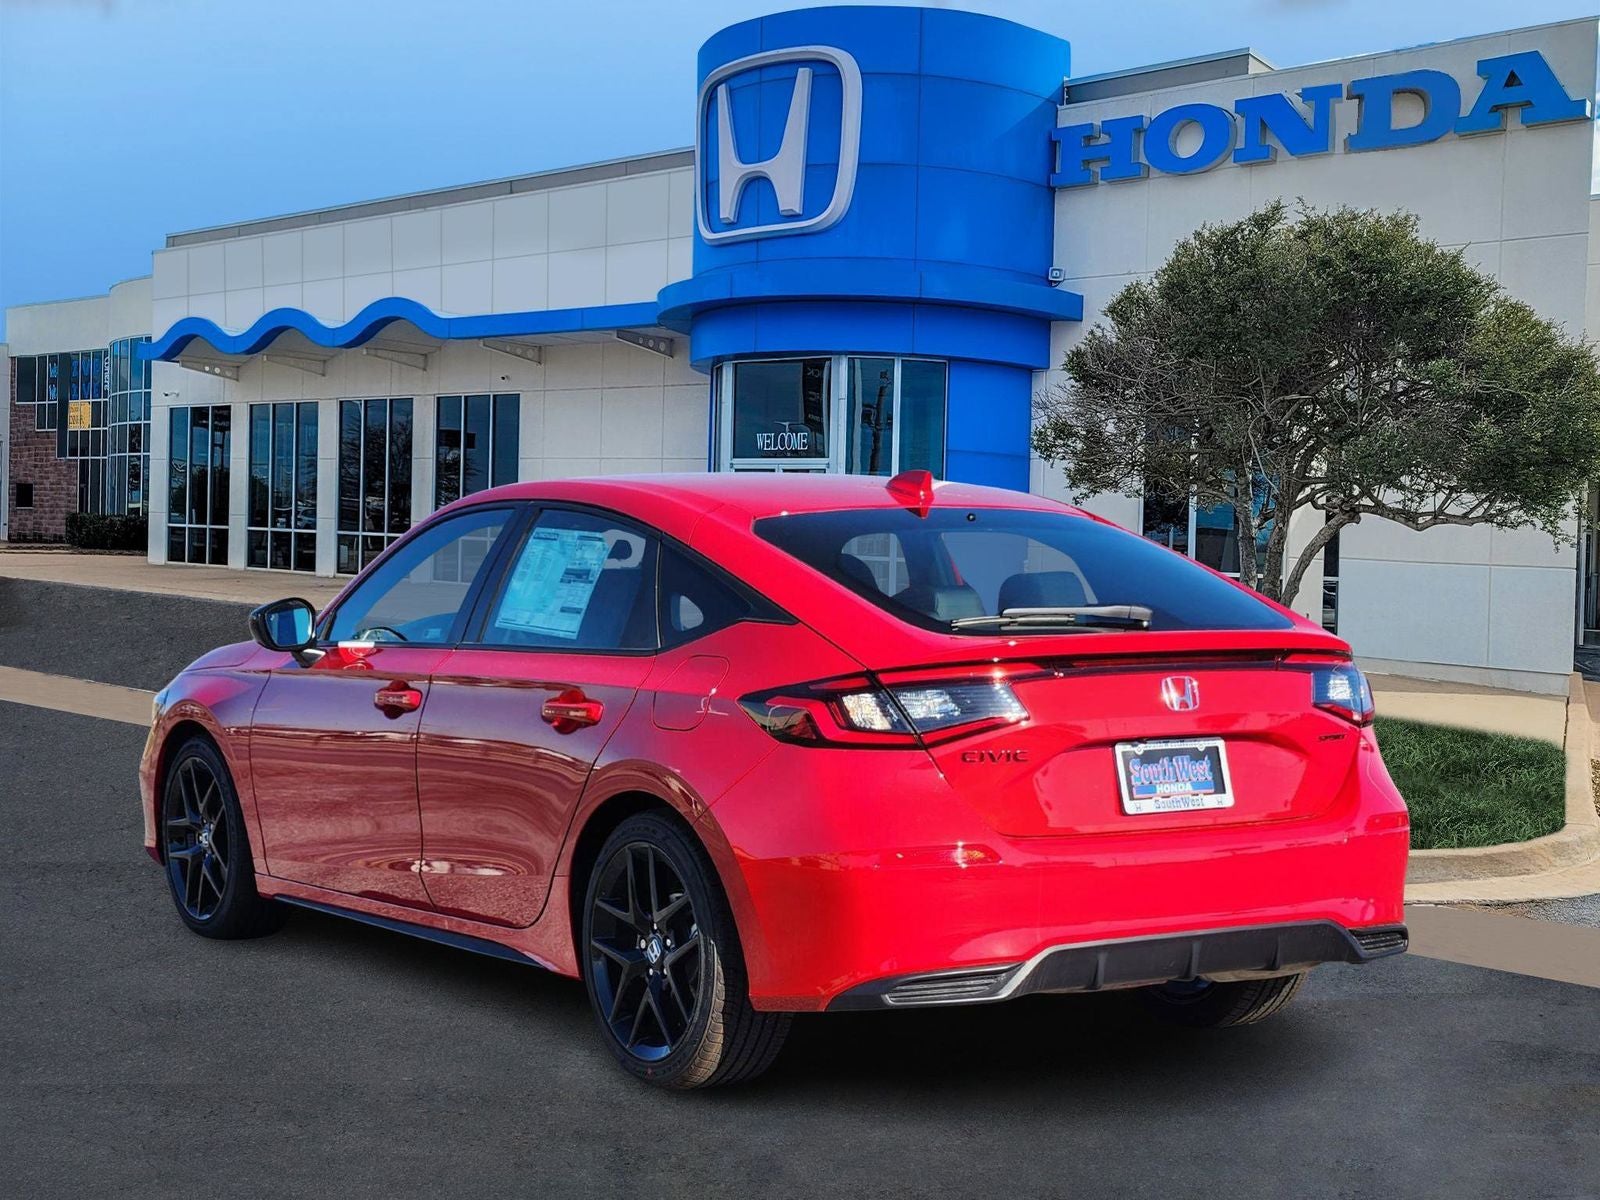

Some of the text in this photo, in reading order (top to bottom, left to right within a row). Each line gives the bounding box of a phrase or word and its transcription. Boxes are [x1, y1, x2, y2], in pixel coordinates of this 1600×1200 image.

[1050, 50, 1592, 188] HONDA
[756, 432, 809, 451] WELCOME
[961, 750, 1029, 763] CIVIC
[1156, 783, 1193, 793] HONDA
